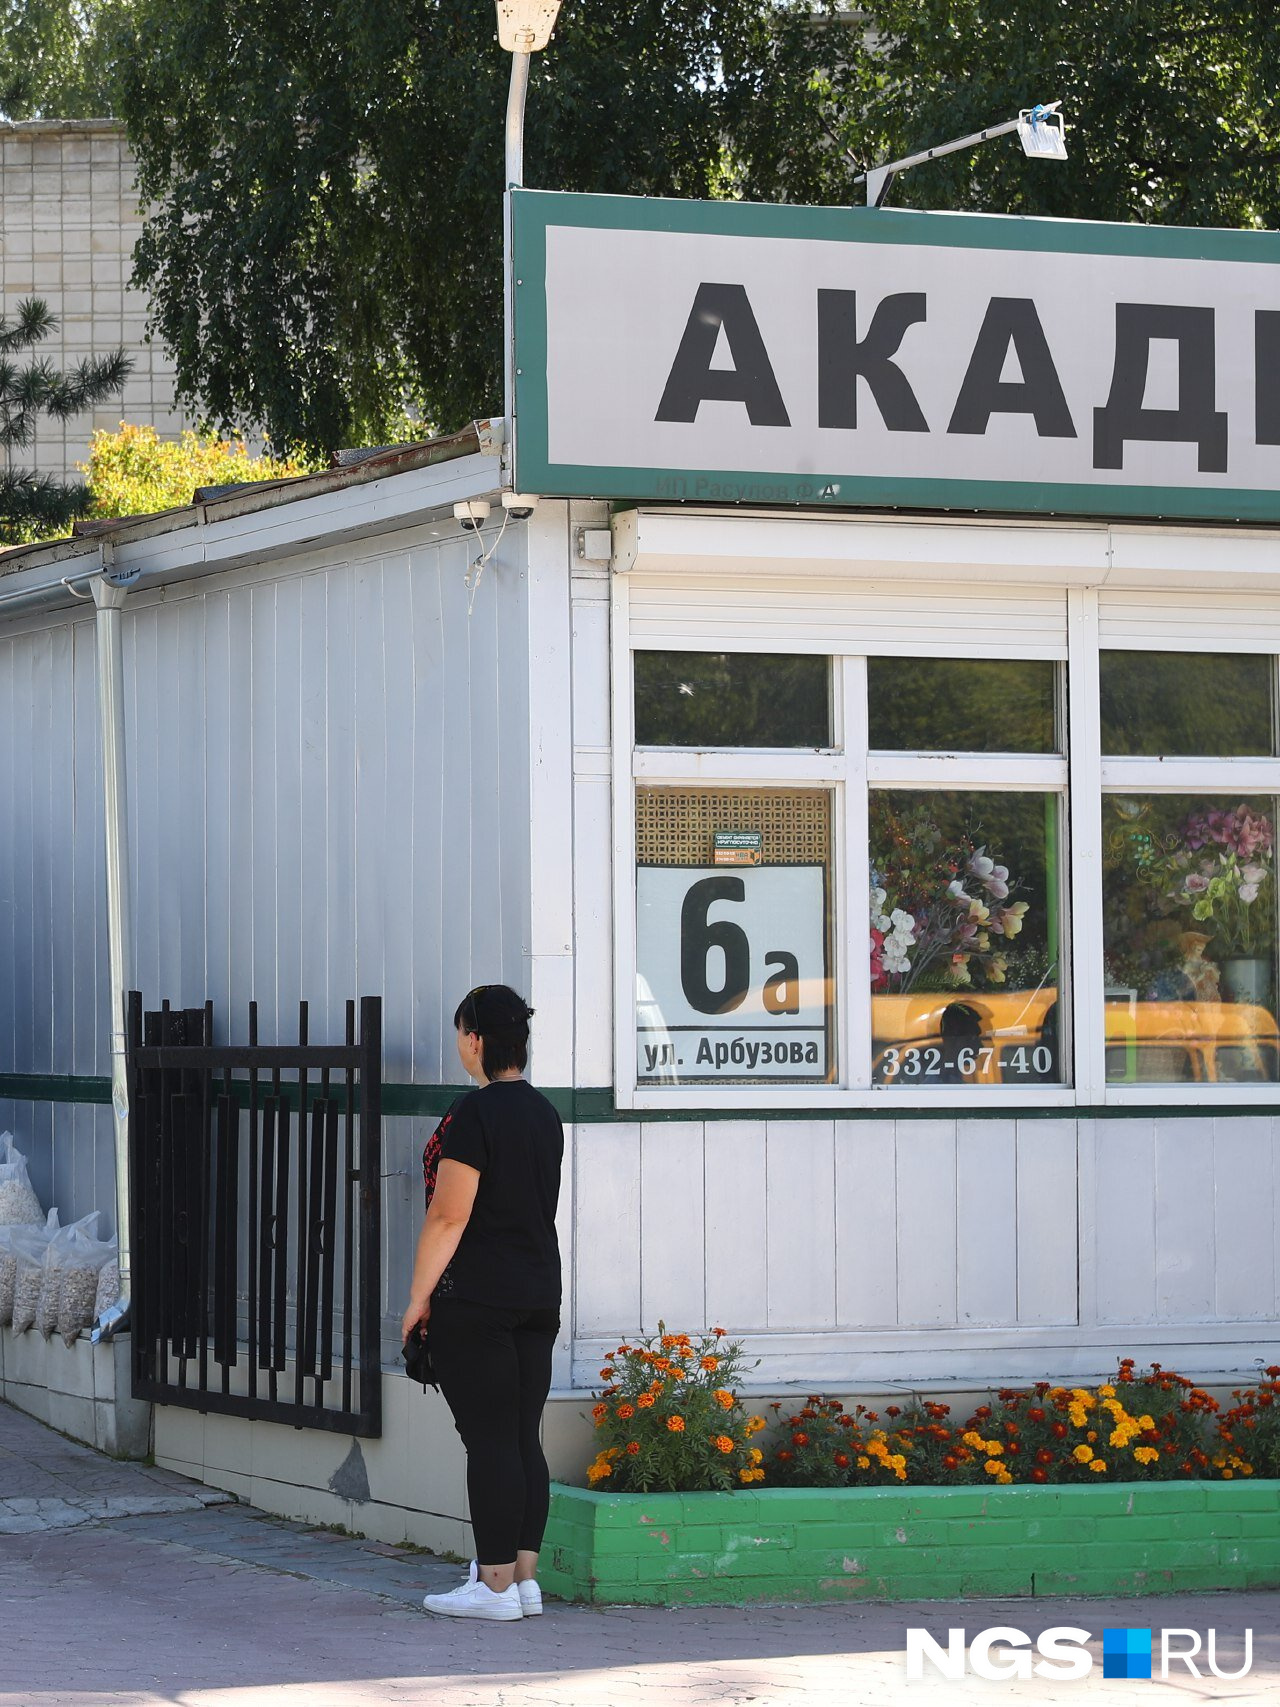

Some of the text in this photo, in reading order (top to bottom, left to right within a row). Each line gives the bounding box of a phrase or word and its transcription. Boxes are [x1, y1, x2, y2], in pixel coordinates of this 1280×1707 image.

[654, 282, 1280, 473] АКАД
[655, 475, 687, 496] ИП
[695, 475, 789, 500] Расулов
[680, 876, 800, 1016] 6а
[644, 1037, 818, 1071] ул. Арбузова
[882, 1046, 1053, 1076] 332-67-40
